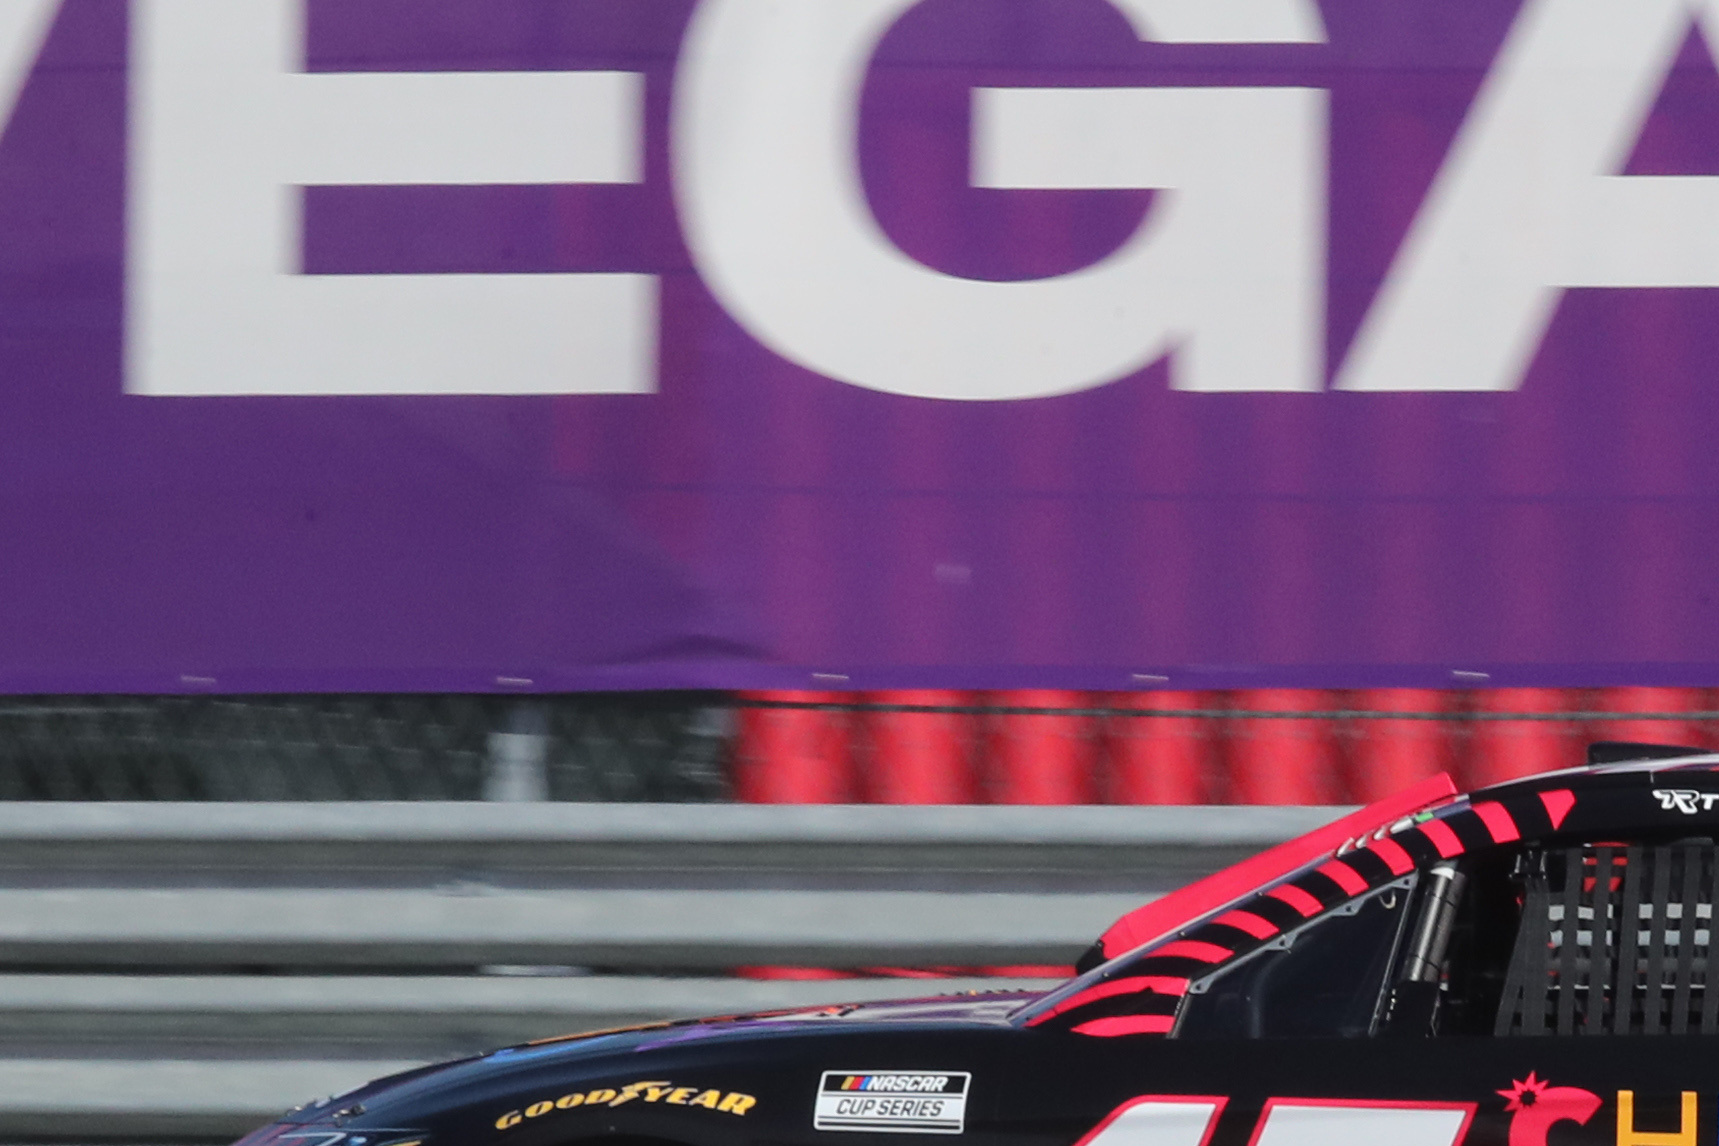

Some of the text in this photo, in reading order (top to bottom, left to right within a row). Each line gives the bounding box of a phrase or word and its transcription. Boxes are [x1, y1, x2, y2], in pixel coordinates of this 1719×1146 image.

[866, 1075, 949, 1092] NASCAR
[494, 1080, 757, 1130] GOODYEAR
[836, 1098, 946, 1117] CUP SERIES
